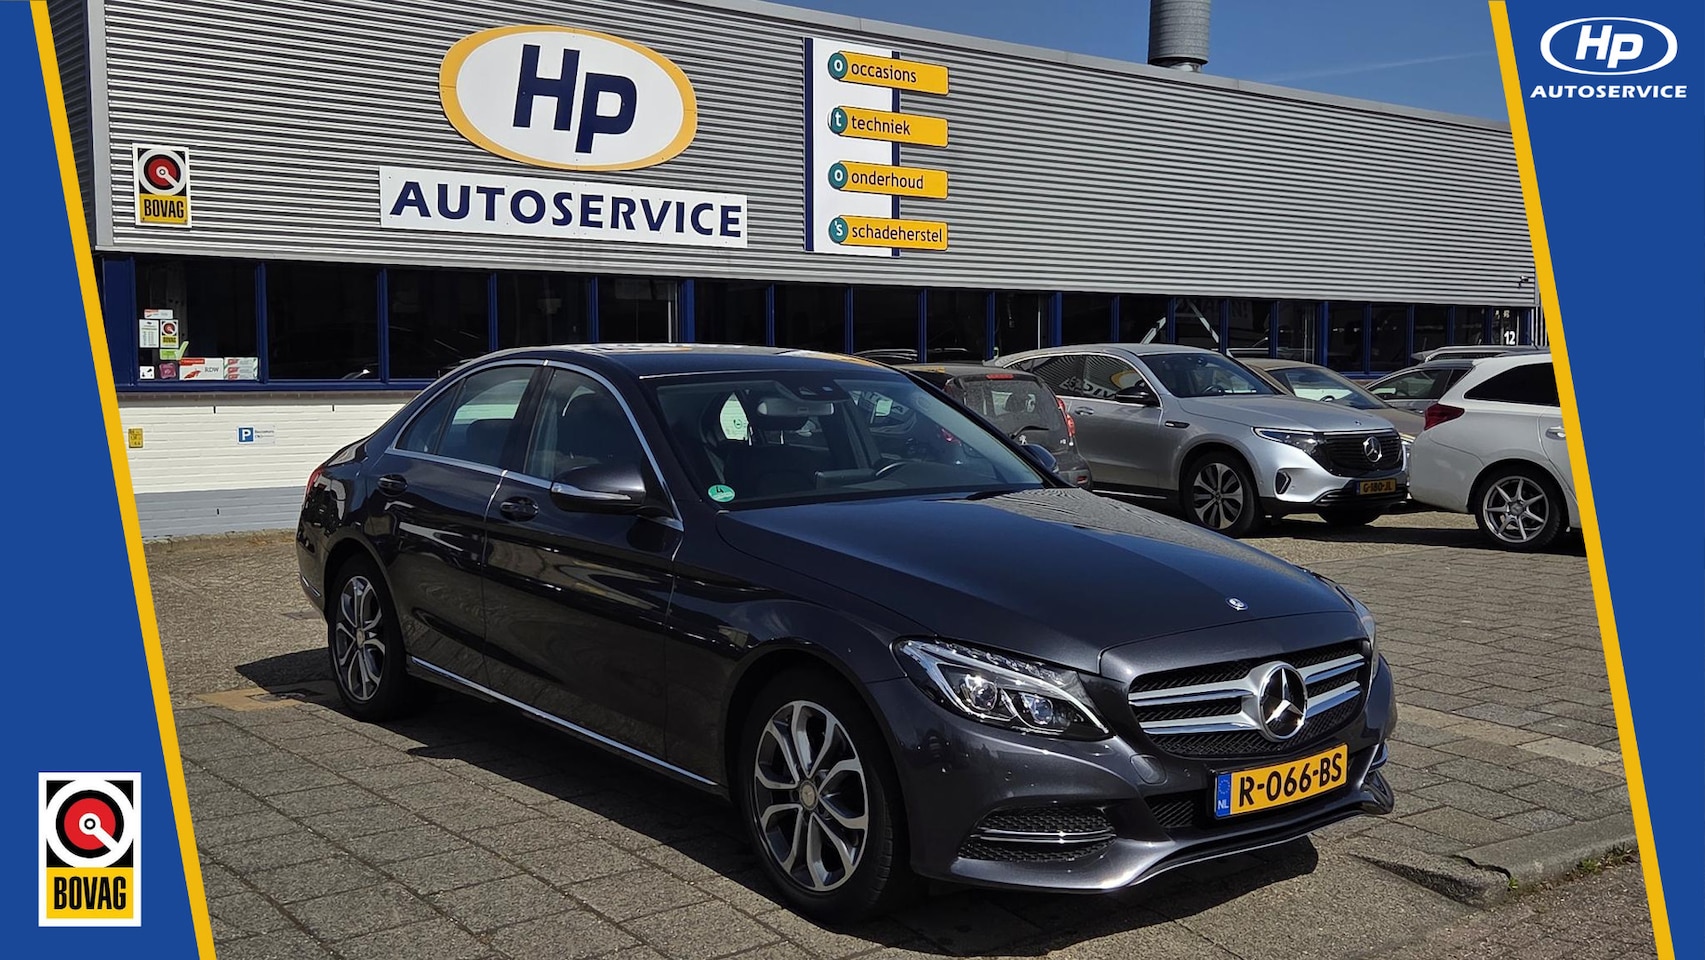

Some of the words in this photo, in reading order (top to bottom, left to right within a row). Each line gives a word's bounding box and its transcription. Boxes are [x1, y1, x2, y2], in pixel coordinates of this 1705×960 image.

[851, 63, 917, 83] occasions
[834, 112, 842, 127] t
[851, 115, 911, 136] techniek
[851, 170, 924, 190] onderhoud
[143, 198, 185, 219] BOVAG
[389, 181, 742, 238] AUTOSERVICE
[851, 224, 943, 243] schadeherstel
[1503, 330, 1516, 346] 12
[242, 429, 252, 441] P
[1239, 753, 1342, 807] R-066-BS
[1217, 799, 1229, 810] NL
